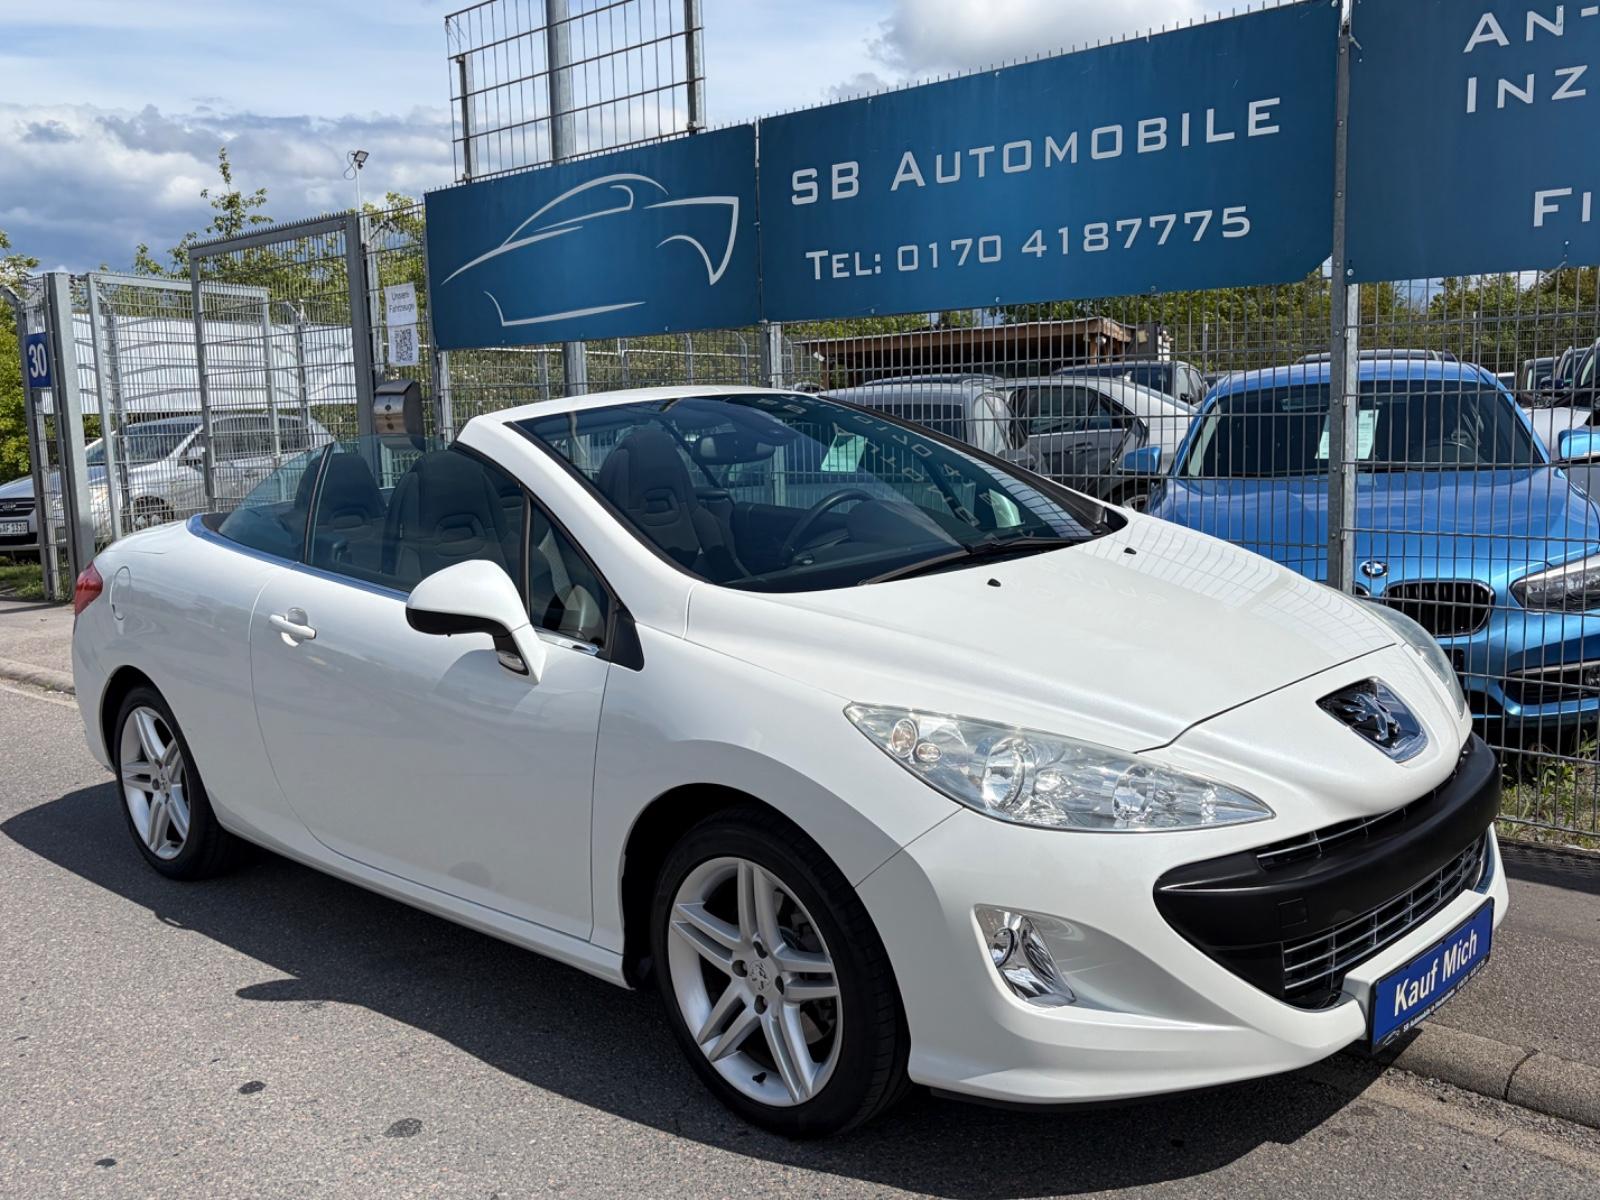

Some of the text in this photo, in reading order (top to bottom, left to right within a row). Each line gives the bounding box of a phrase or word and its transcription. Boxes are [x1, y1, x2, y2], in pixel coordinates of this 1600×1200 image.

[791, 97, 1281, 206] SB AUTOMOBILE
[897, 234, 1002, 272] 0170
[1021, 205, 1252, 259] 4187775
[28, 343, 48, 378] 30
[1394, 929, 1478, 1017] Kauf Mich
